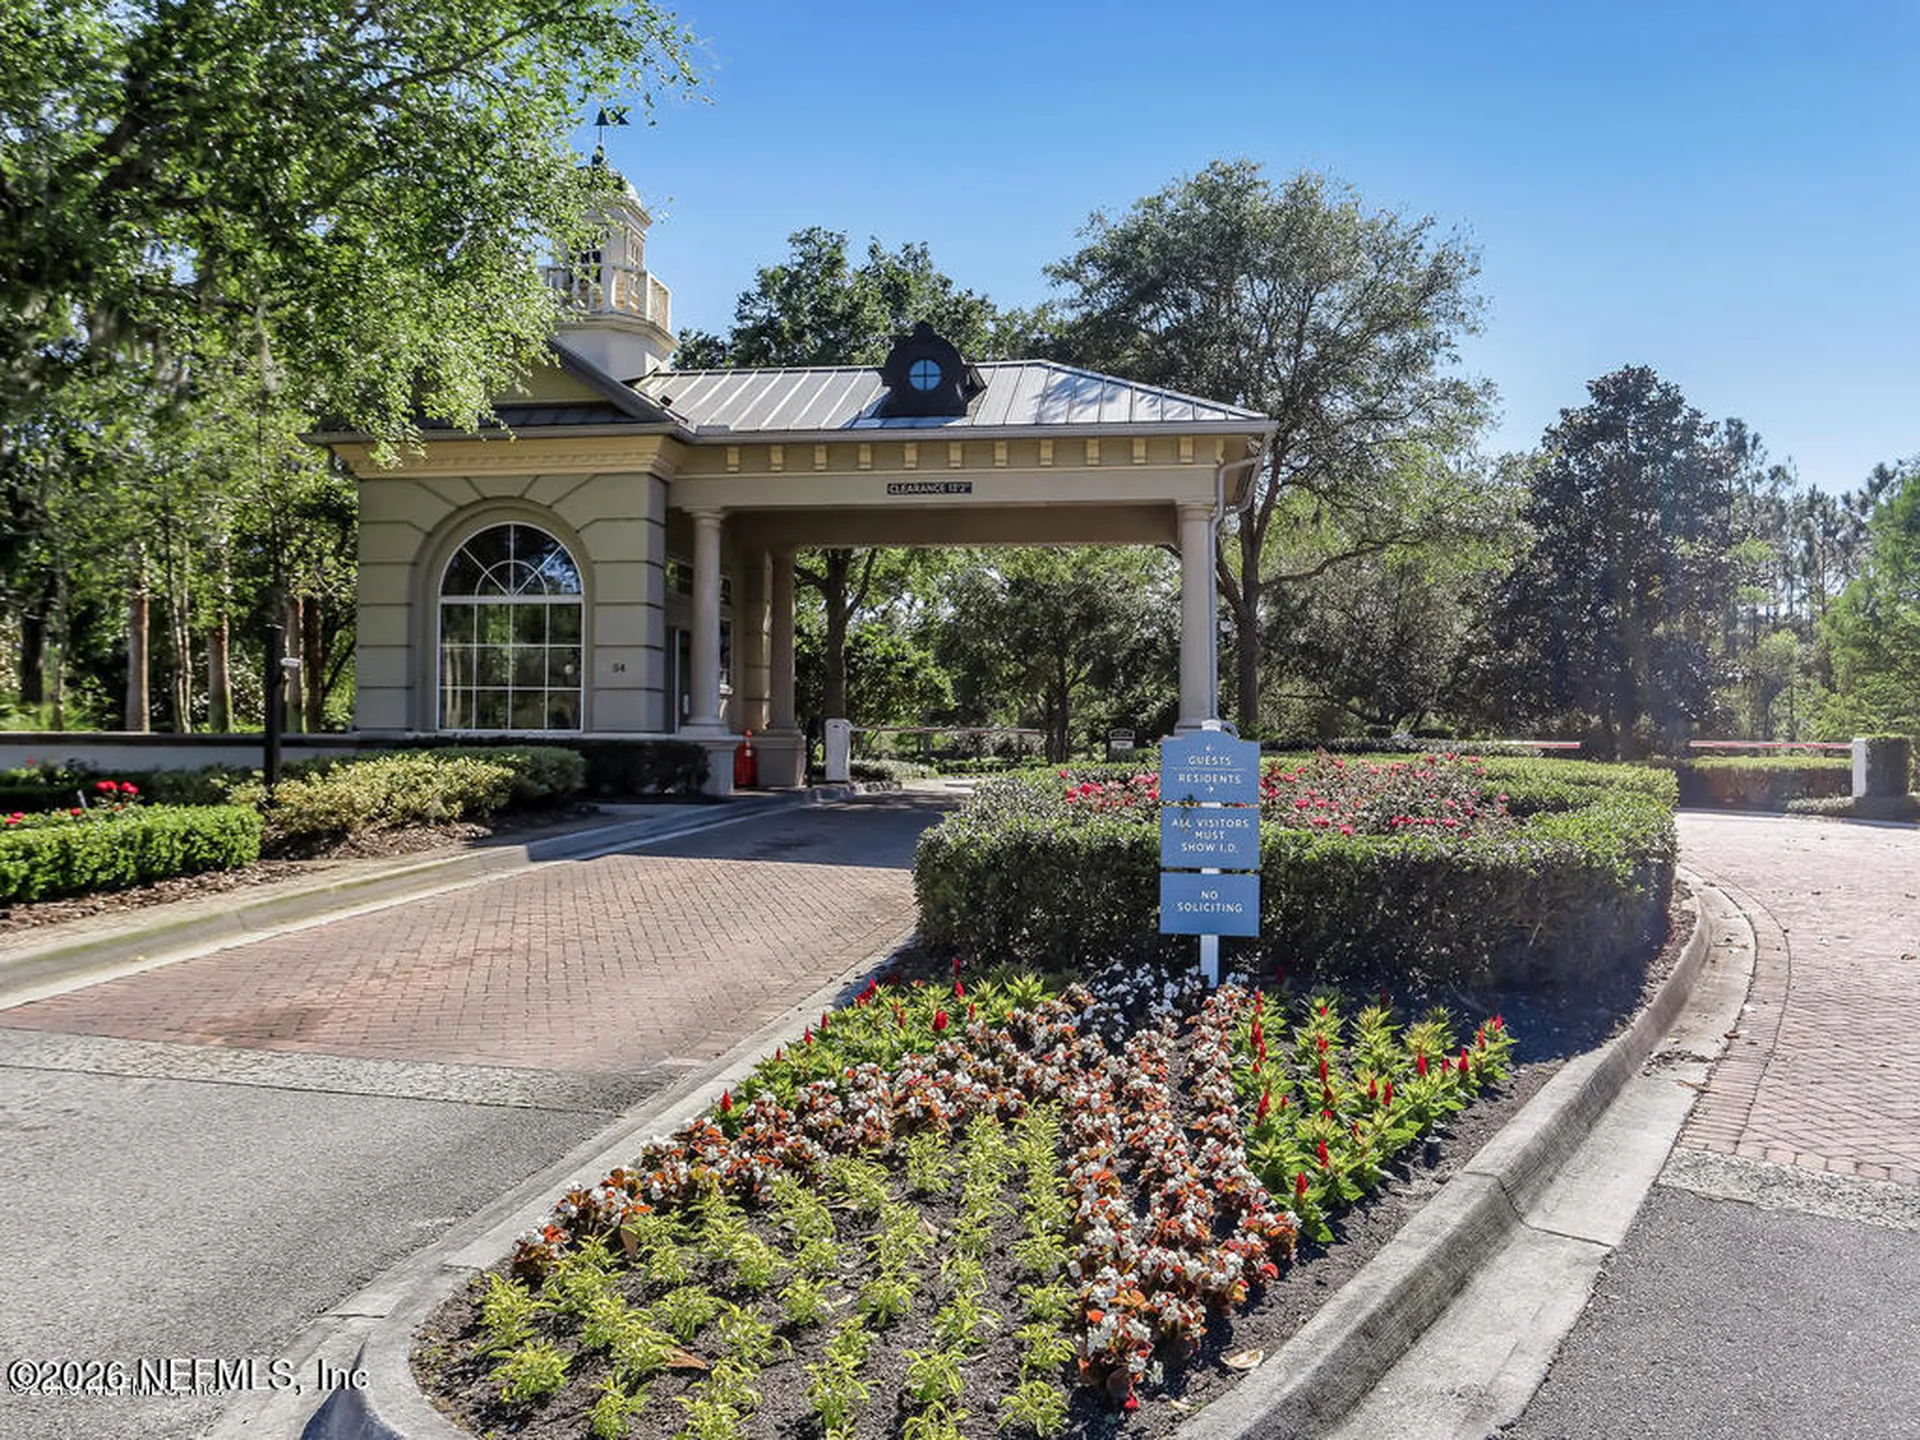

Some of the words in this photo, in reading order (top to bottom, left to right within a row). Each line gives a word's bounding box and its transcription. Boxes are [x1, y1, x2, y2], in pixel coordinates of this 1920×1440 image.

[889, 483, 945, 494] CLEARANCE
[1188, 755, 1231, 765] GUESTS
[1178, 774, 1242, 784] RESIDENTS
[1171, 818, 1192, 828] ALL
[1196, 818, 1250, 829] VISITORS
[1195, 830, 1225, 840] MUST
[1181, 843, 1215, 852] SHOW
[1201, 890, 1218, 900] NO
[1176, 902, 1243, 913] SOLICITING
